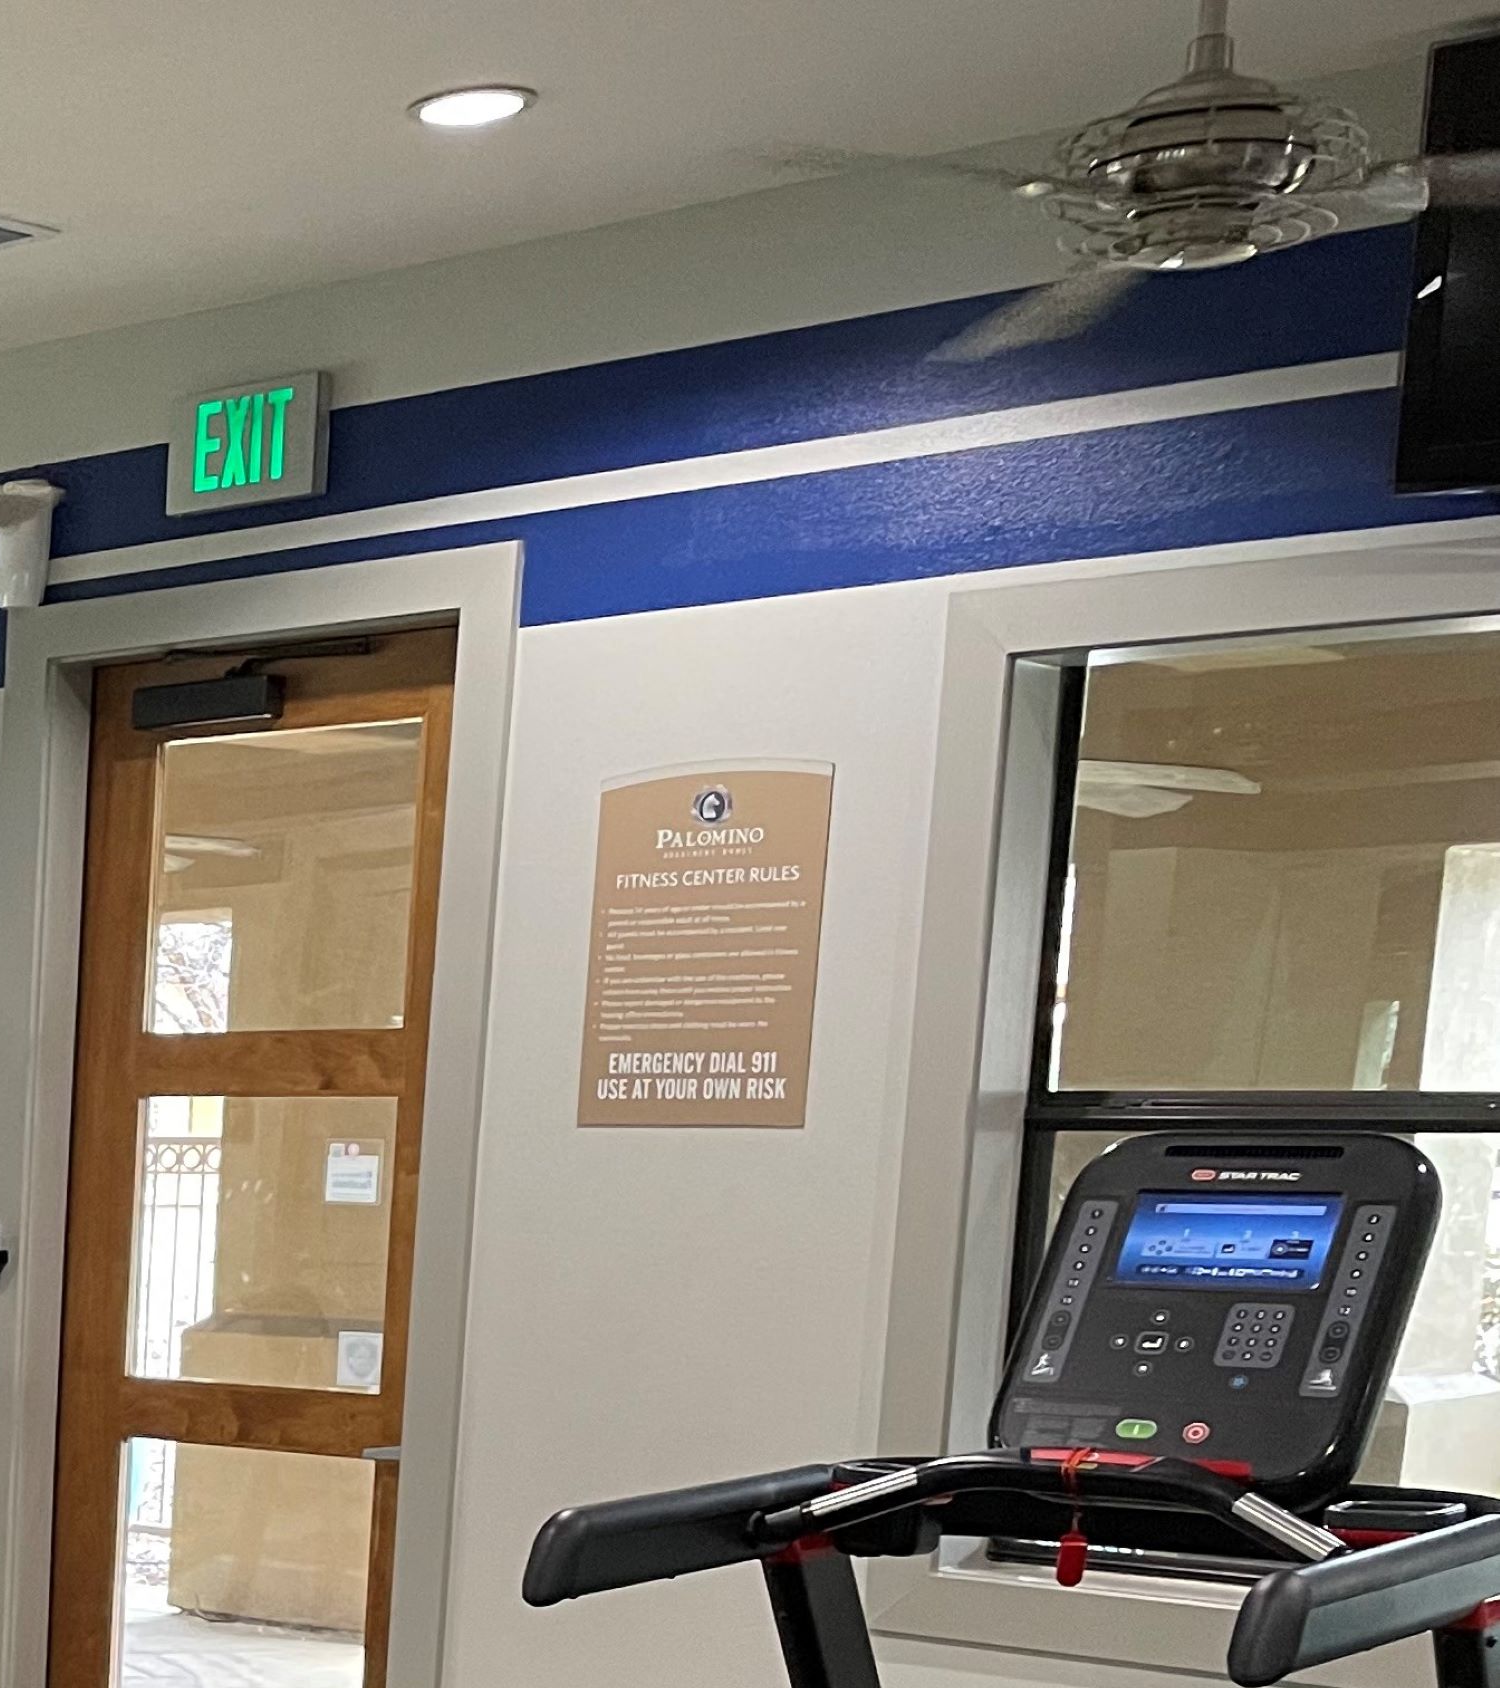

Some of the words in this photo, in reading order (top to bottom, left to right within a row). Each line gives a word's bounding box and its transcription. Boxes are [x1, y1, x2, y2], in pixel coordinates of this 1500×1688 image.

[194, 387, 293, 493] EXIT
[616, 869, 679, 889] FITNESS
[682, 868, 745, 886] CENTER
[749, 865, 800, 882] RULES
[608, 1048, 705, 1074] EMERGENCY
[709, 1047, 746, 1073] DIAL
[751, 1046, 777, 1073] 911
[597, 1079, 628, 1100] USE
[631, 1079, 652, 1100] AT
[655, 1079, 698, 1100] YOUR
[703, 1078, 741, 1100] OWN
[746, 1078, 787, 1100] RISK
[1218, 1171, 1258, 1181] STAR
[1260, 1172, 1302, 1182] TRAC
